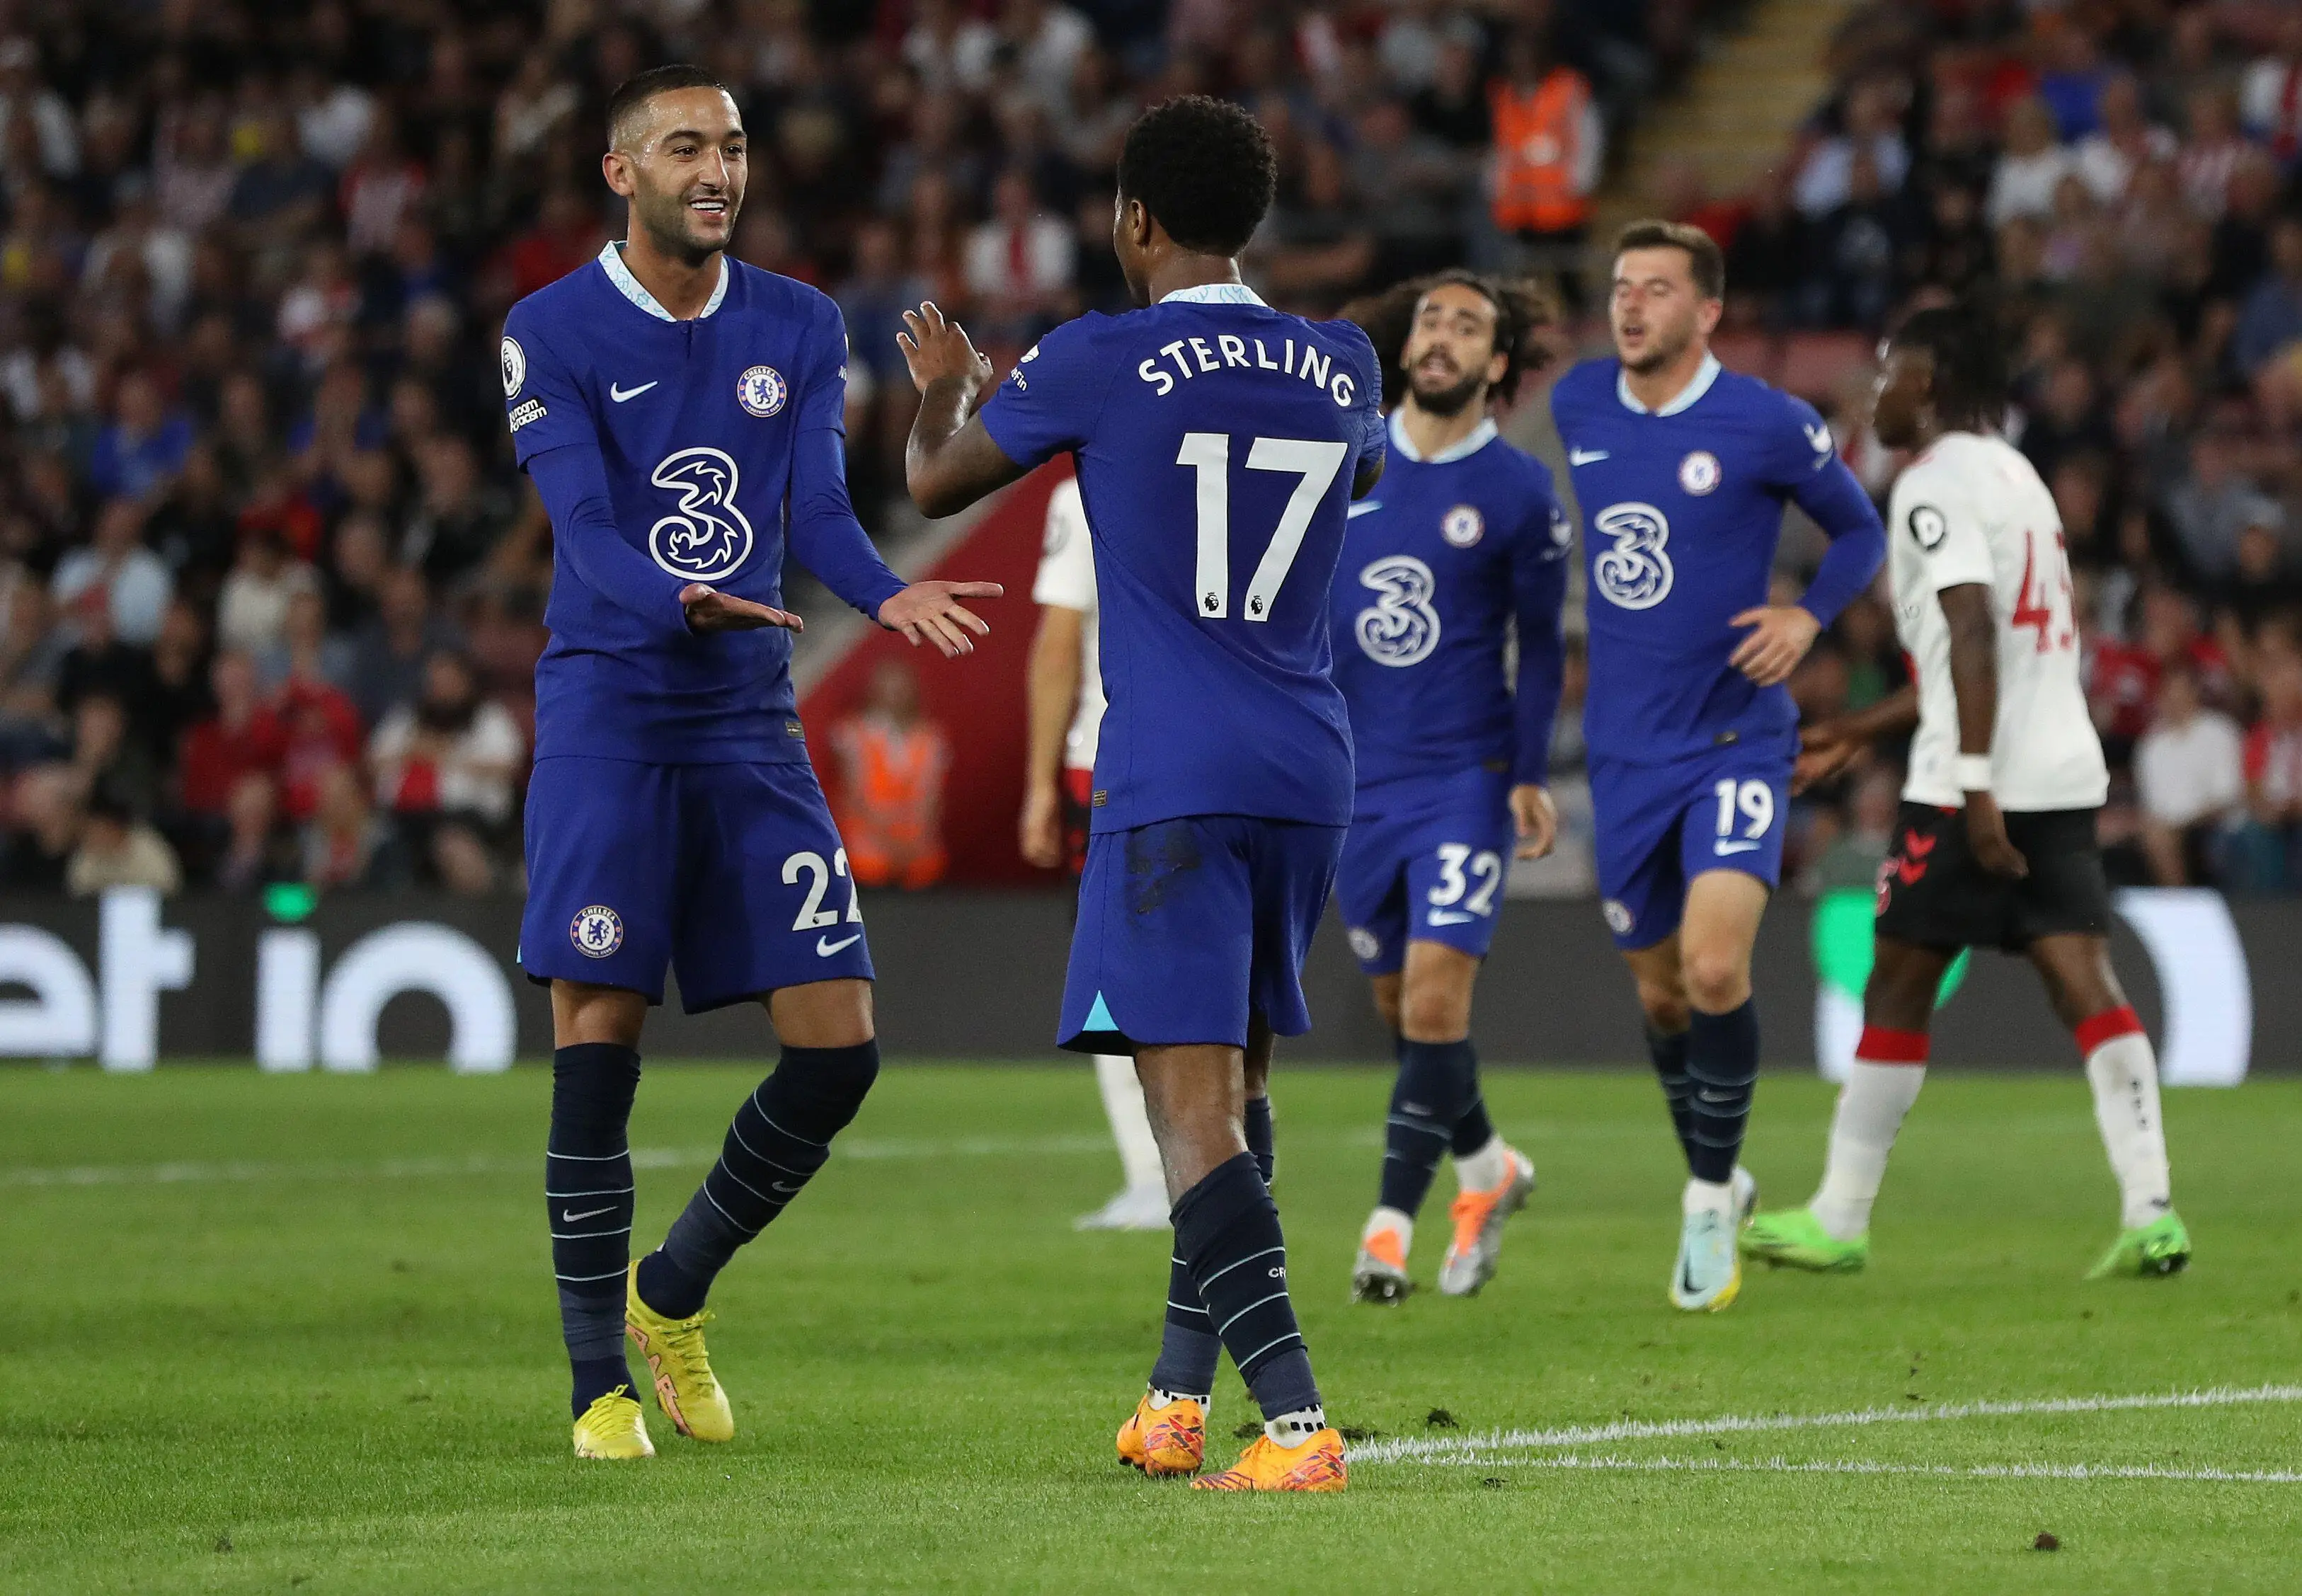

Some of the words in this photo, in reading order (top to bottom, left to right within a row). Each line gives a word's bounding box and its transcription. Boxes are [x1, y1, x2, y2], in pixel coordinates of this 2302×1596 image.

[745, 368, 775, 379] CHELSEA
[1138, 335, 1355, 407] STERLING
[649, 447, 753, 581] 3
[1176, 432, 1348, 622] 17
[1593, 502, 1675, 610] 3
[1355, 556, 1441, 667] 3
[1714, 779, 1774, 839] 19
[582, 907, 616, 922] CHELSEA
[1427, 842, 1502, 917] 32
